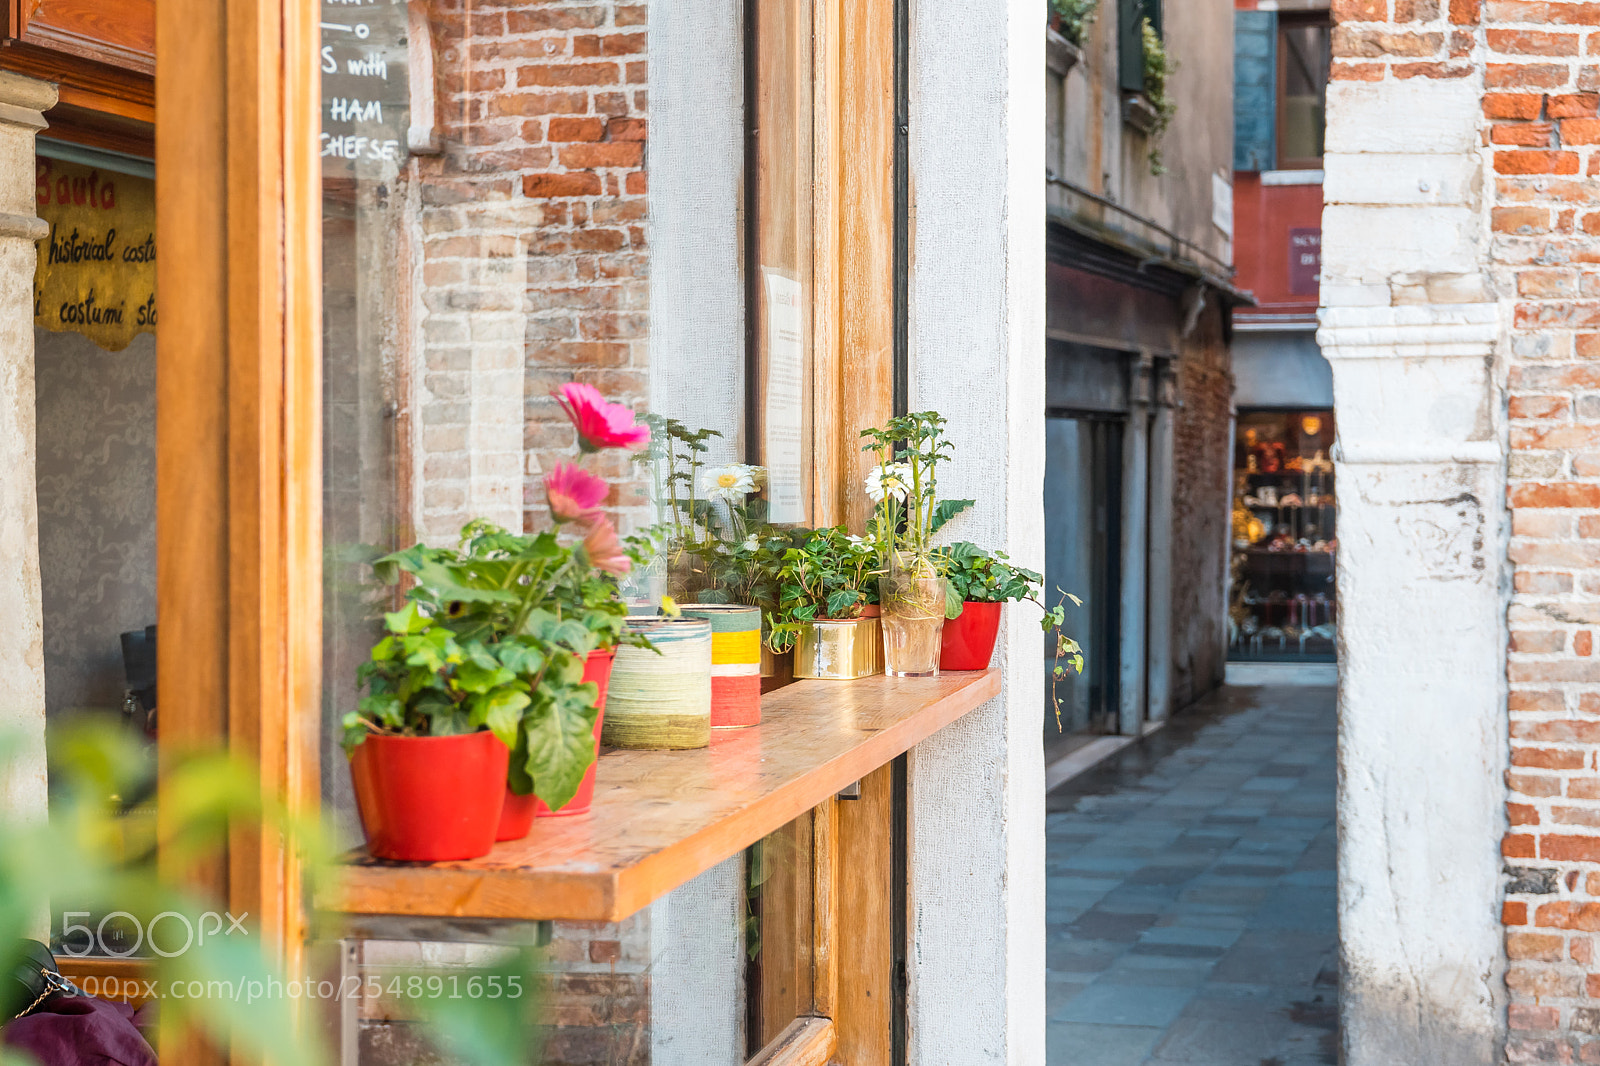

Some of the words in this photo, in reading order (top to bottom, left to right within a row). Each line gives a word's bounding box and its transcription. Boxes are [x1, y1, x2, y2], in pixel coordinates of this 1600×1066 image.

[347, 53, 387, 80] with
[330, 97, 383, 124] HAM
[48, 223, 115, 265] historical
[60, 288, 125, 325] costumi
